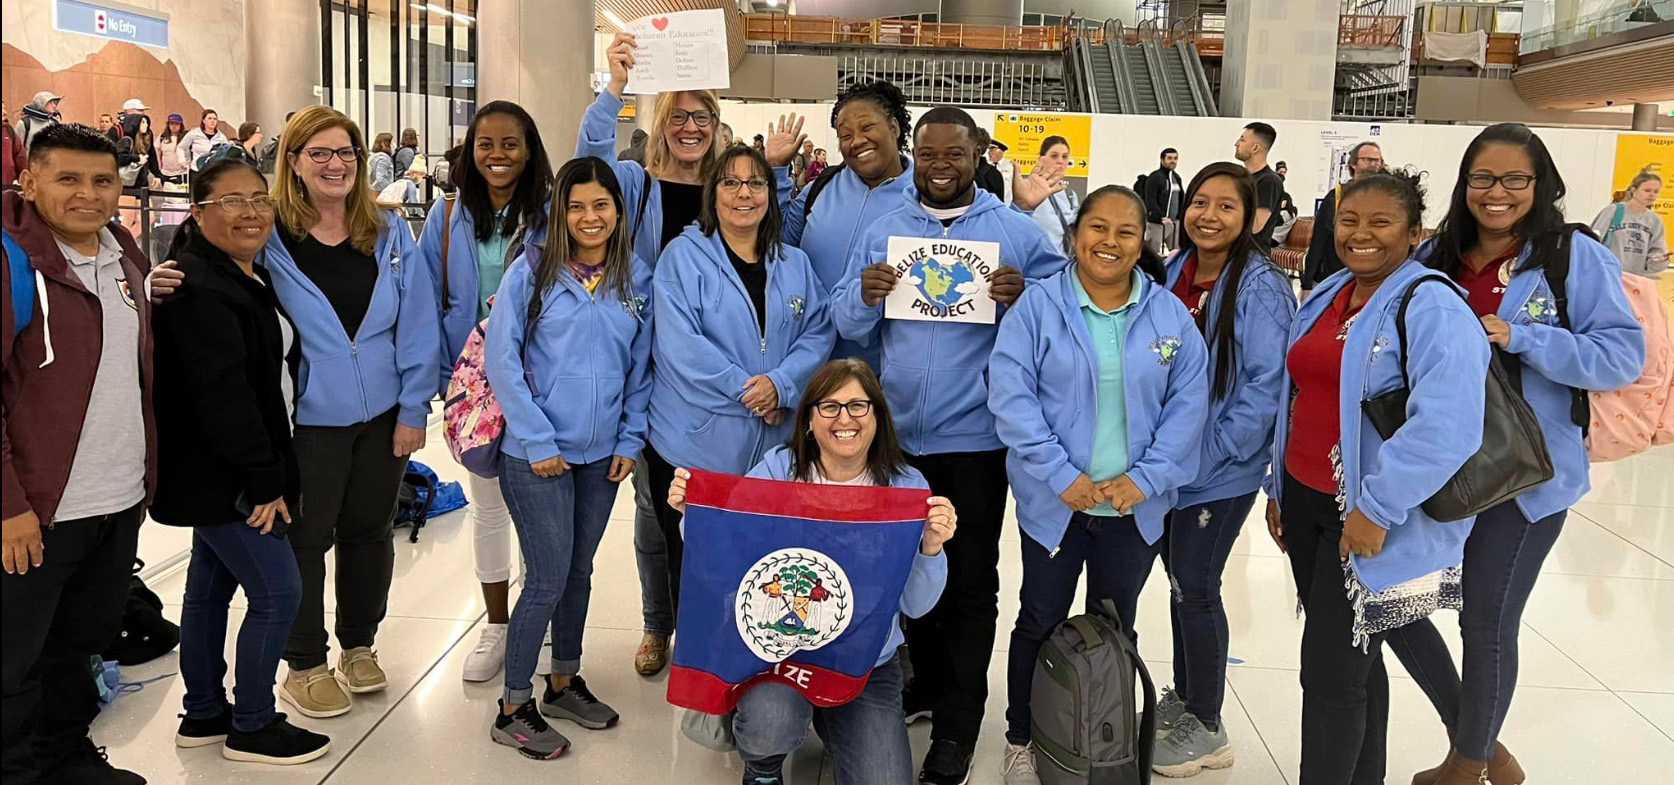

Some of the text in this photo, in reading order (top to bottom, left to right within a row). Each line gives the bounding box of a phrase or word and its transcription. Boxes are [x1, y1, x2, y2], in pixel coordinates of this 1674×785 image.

[108, 18, 137, 38] No Entry
[1648, 137, 1674, 145] Baggage
[895, 247, 927, 279] BELIZE
[911, 298, 976, 319] PROJECT
